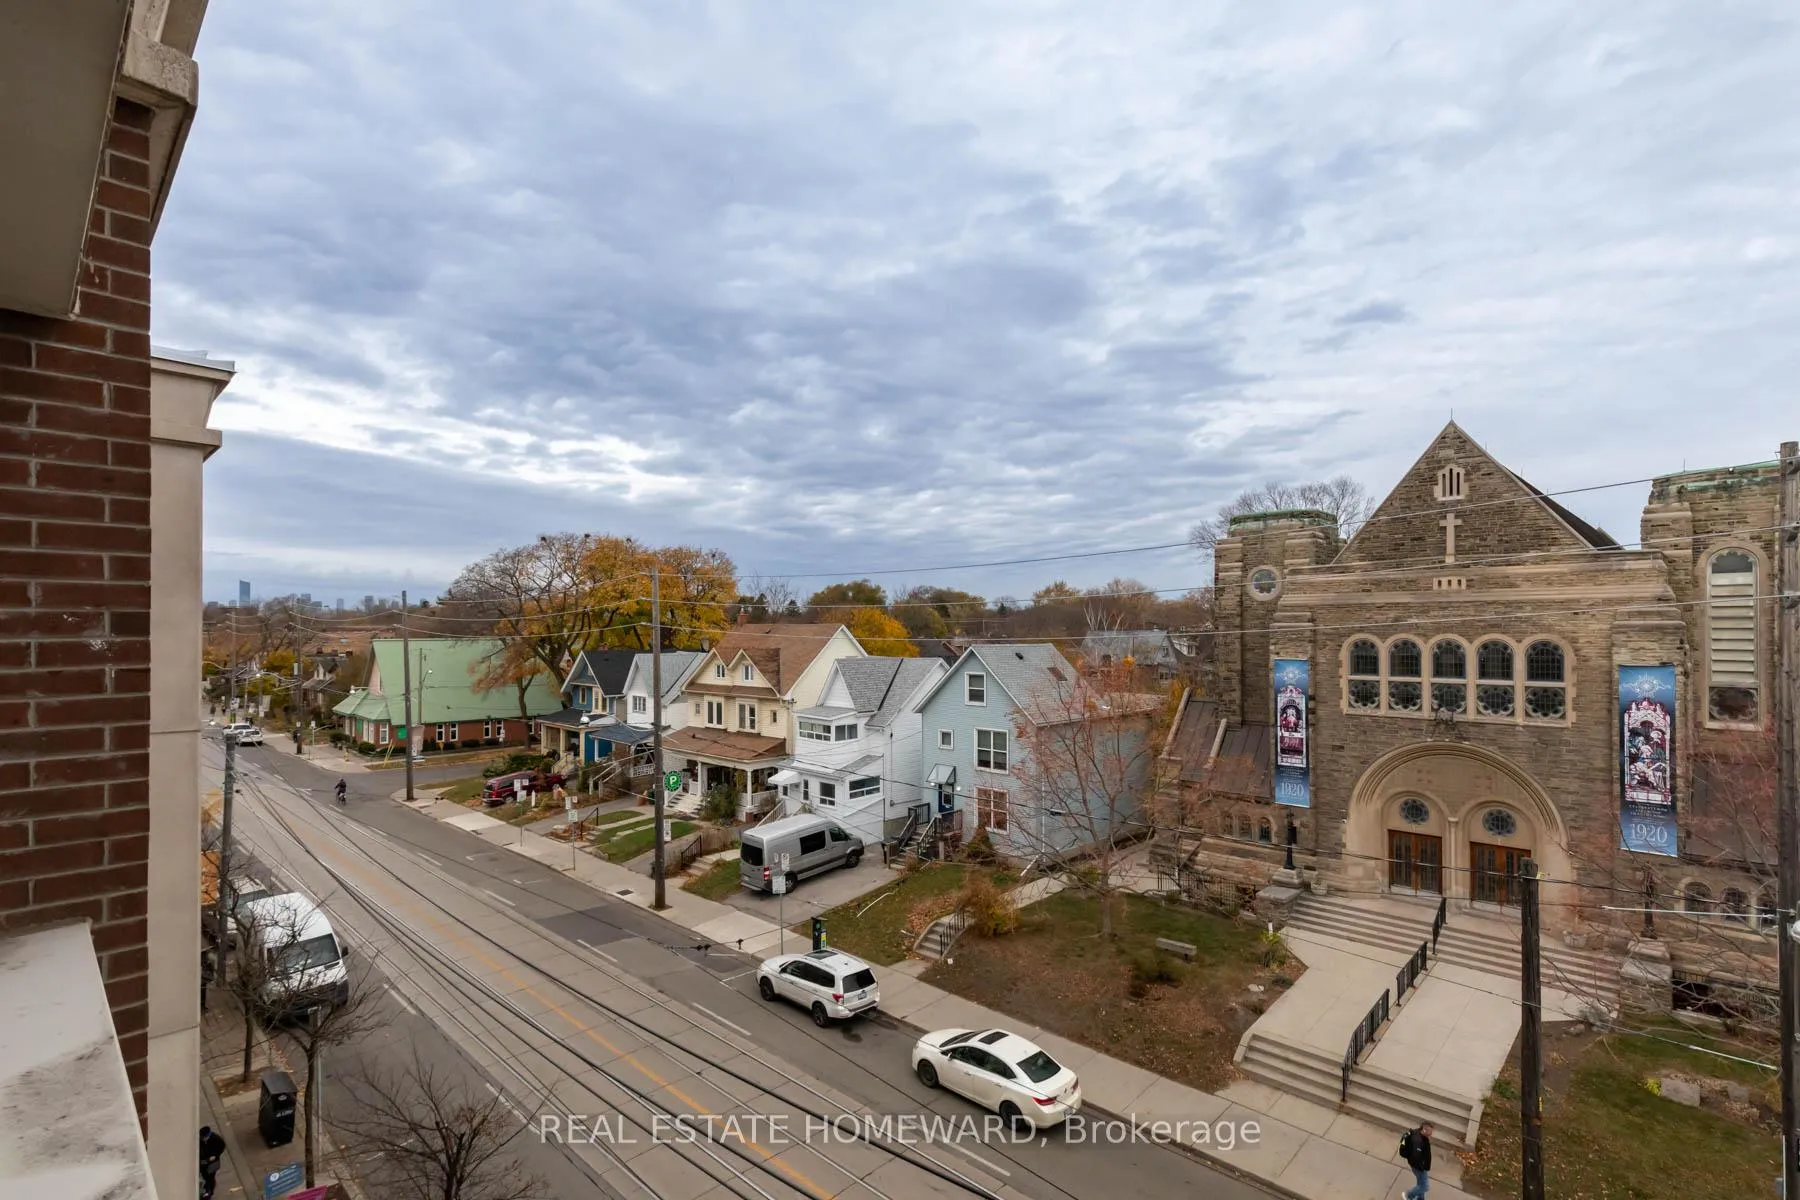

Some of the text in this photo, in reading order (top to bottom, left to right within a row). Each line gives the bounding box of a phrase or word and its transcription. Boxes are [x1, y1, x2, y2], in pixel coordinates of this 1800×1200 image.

[669, 775, 677, 786] P
[1281, 782, 1304, 798] 1920
[1630, 823, 1668, 843] 1920
